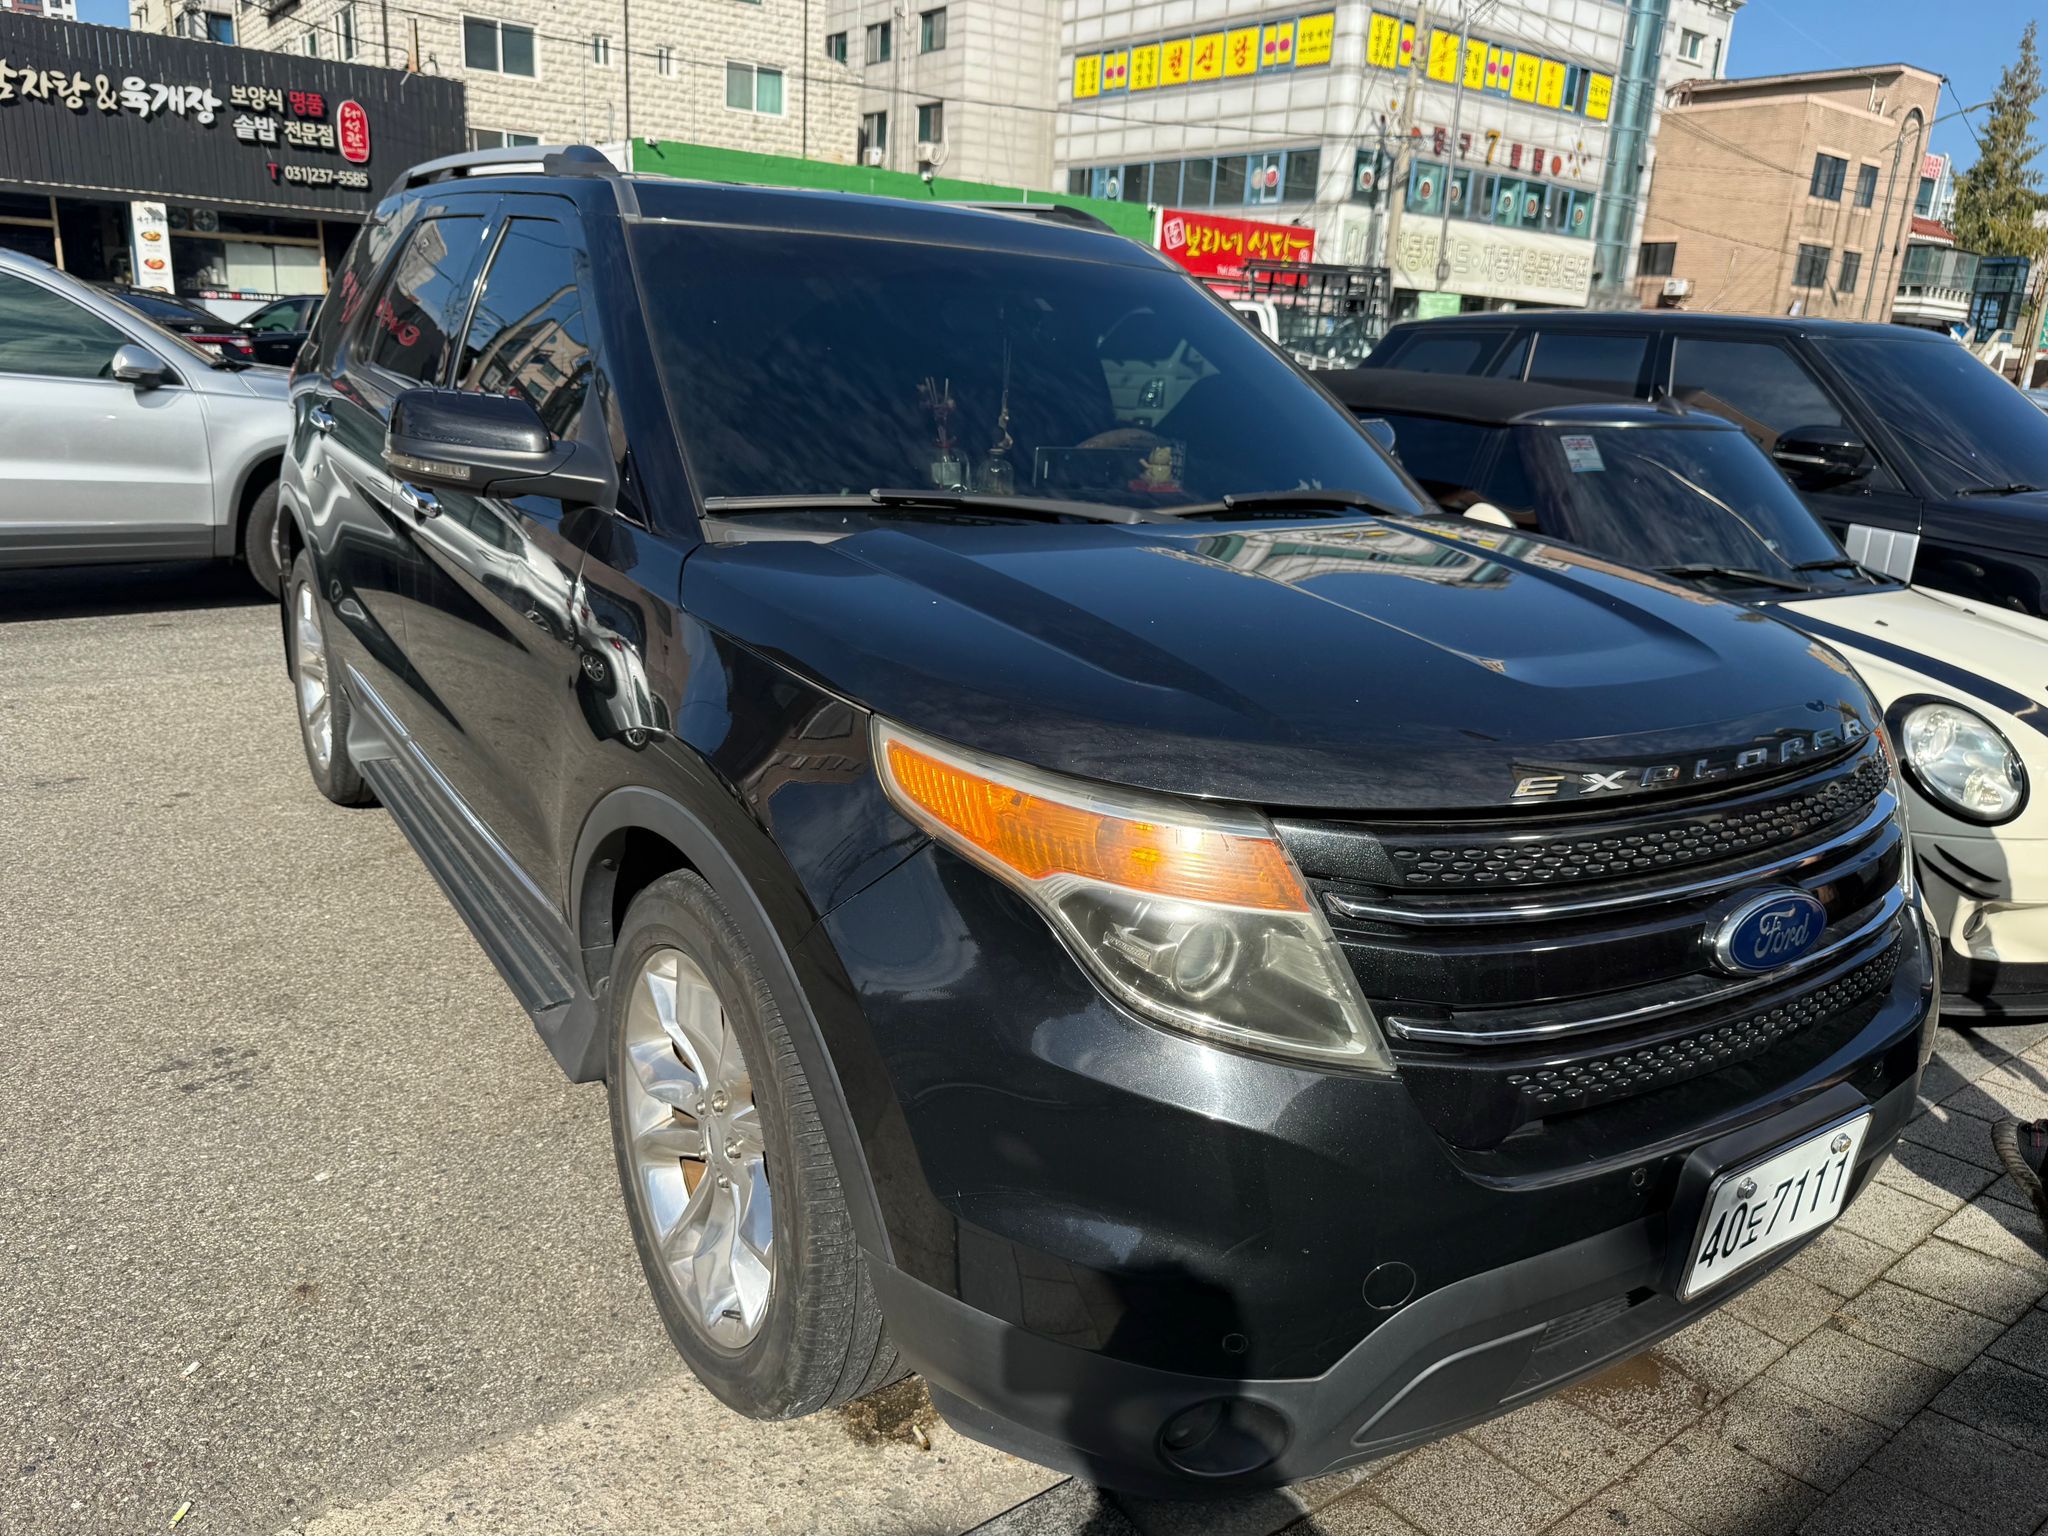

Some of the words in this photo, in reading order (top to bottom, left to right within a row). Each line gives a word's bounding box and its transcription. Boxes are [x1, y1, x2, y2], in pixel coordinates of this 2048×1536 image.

[120, 76, 223, 124] 육개장
[230, 85, 283, 113] 보양식
[289, 90, 324, 117] 명품
[233, 114, 279, 142] 솥밥
[284, 120, 335, 148] 전문점
[267, 163, 279, 180] T
[285, 165, 369, 187] 031)237-5585
[1185, 223, 1243, 257] 보리네
[1248, 230, 1312, 267] 식당
[1511, 719, 1864, 798] EXPLORER
[1754, 903, 1810, 959] Ford
[1698, 1153, 1849, 1268] 40도7111
